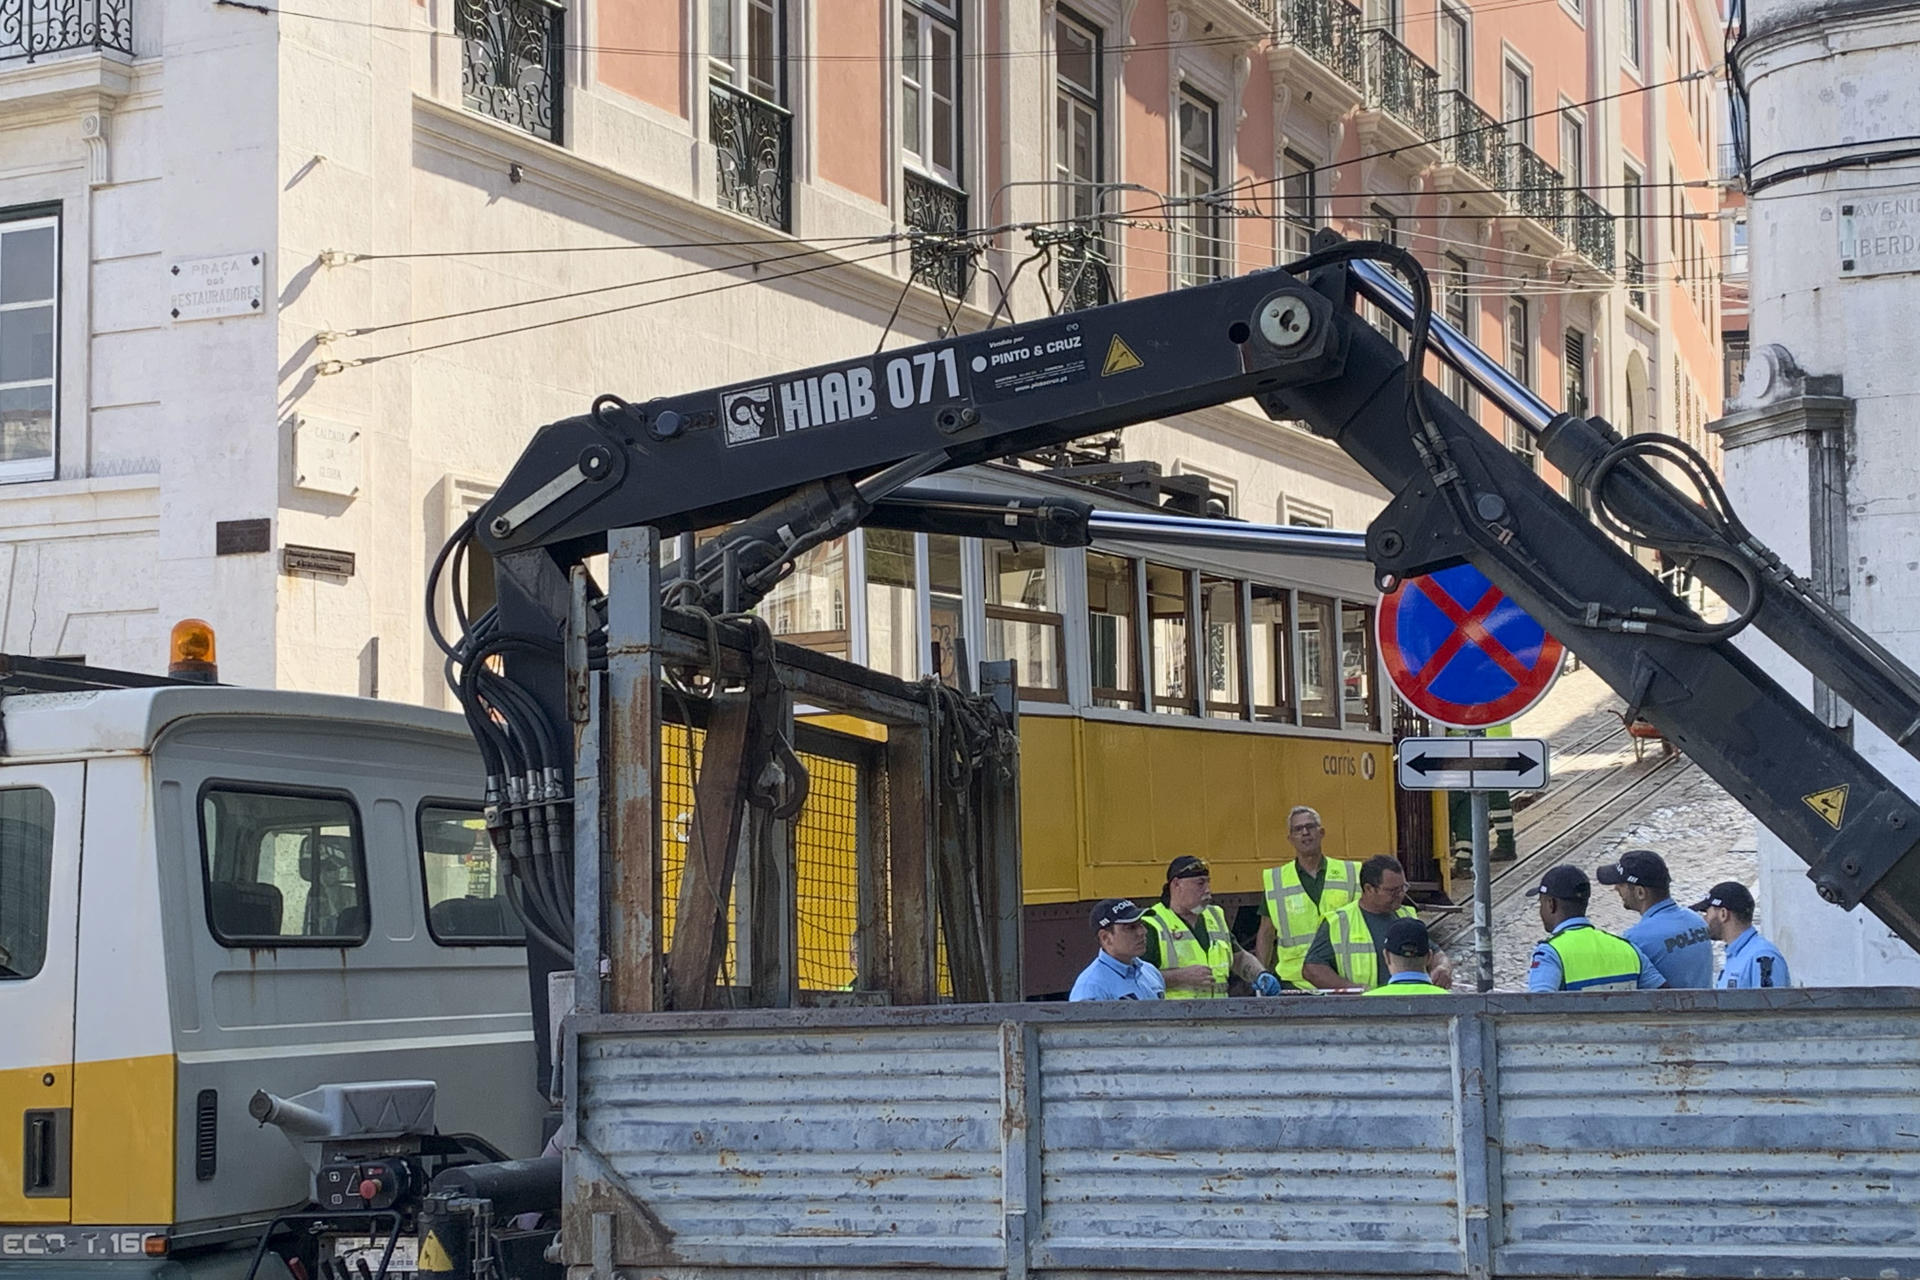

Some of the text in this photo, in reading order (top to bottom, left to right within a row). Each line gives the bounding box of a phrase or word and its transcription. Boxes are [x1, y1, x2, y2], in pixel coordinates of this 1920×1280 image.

[1855, 198, 1920, 218] AVENI
[1840, 234, 1920, 259] LIBERD
[191, 260, 240, 276] PRAÇA
[170, 285, 261, 308] RESTAURADORES
[991, 336, 1082, 366] PINTO & CRUZ
[779, 366, 876, 432] HIAB
[886, 347, 961, 409] 071
[1322, 748, 1357, 776] carris
